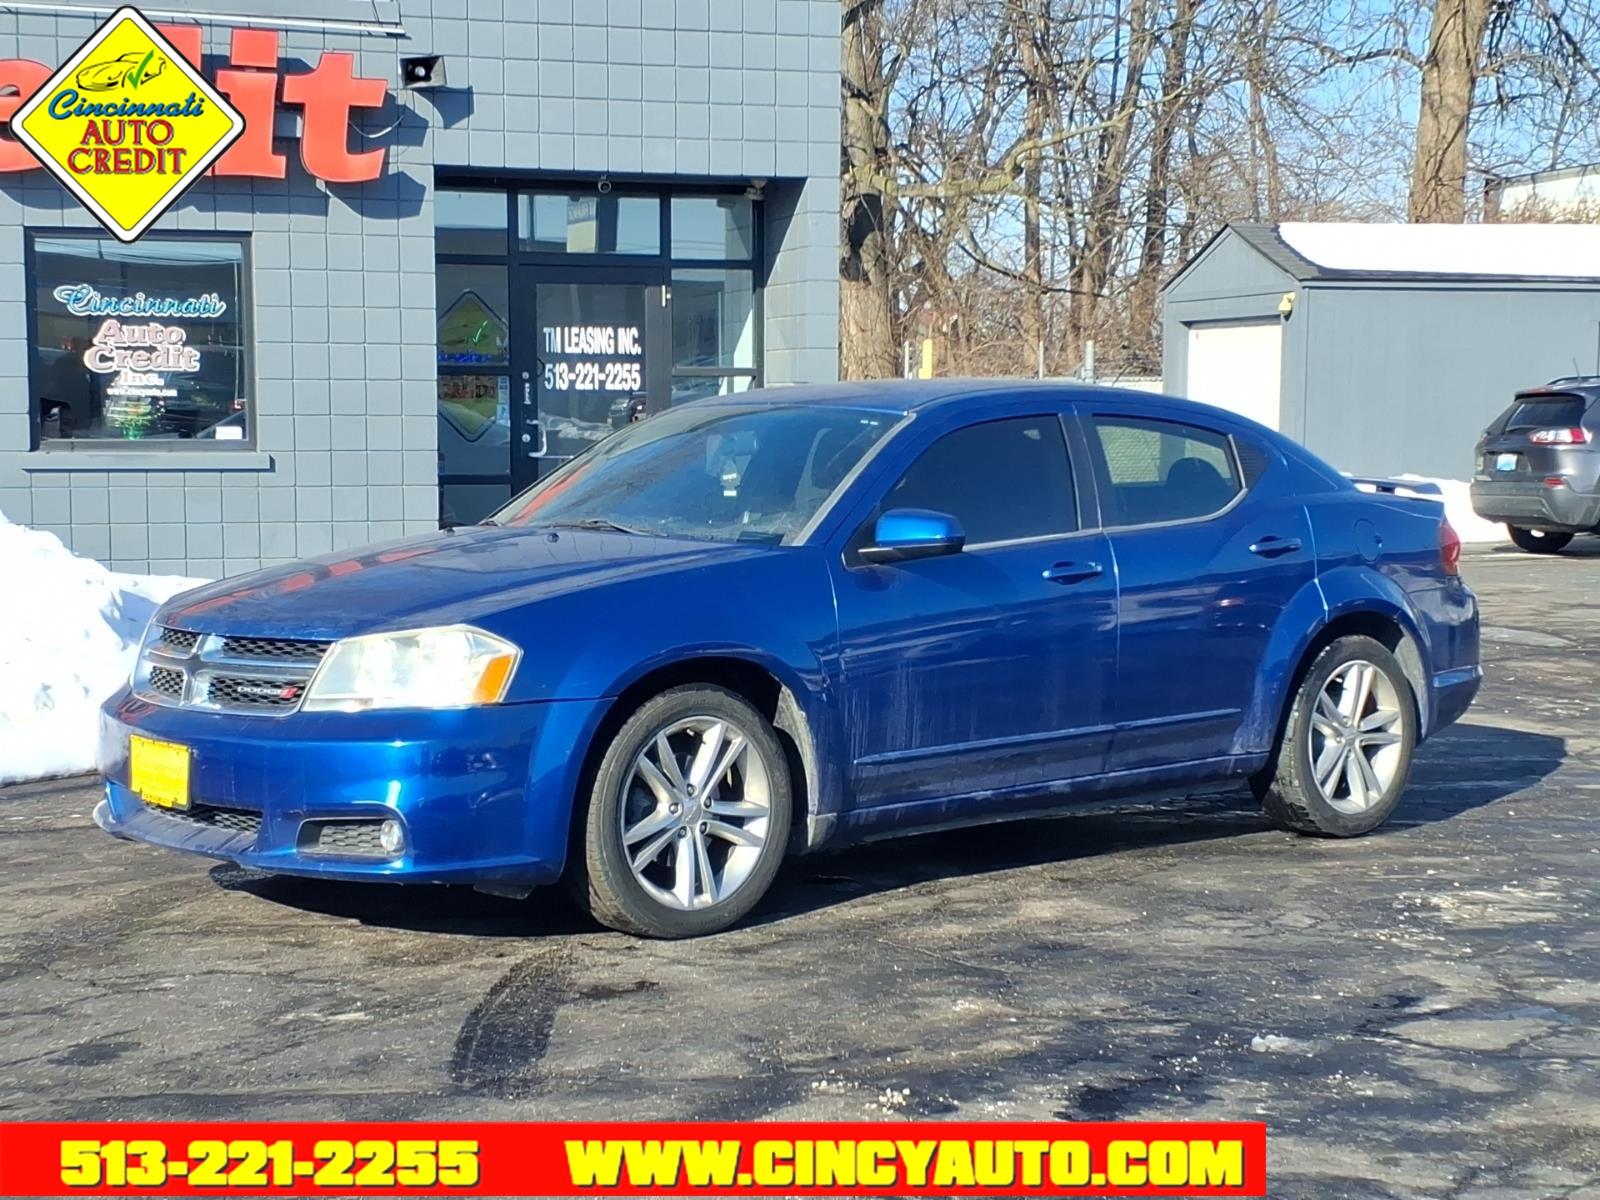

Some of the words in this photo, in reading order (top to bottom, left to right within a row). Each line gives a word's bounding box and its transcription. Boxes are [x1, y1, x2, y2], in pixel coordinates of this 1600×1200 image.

[53, 284, 227, 318] Cincinnati
[92, 319, 186, 346] Auto
[564, 326, 615, 354] LEASING
[617, 326, 642, 355] INC.
[83, 344, 201, 373] Credit
[544, 362, 641, 391] 513-221-2255
